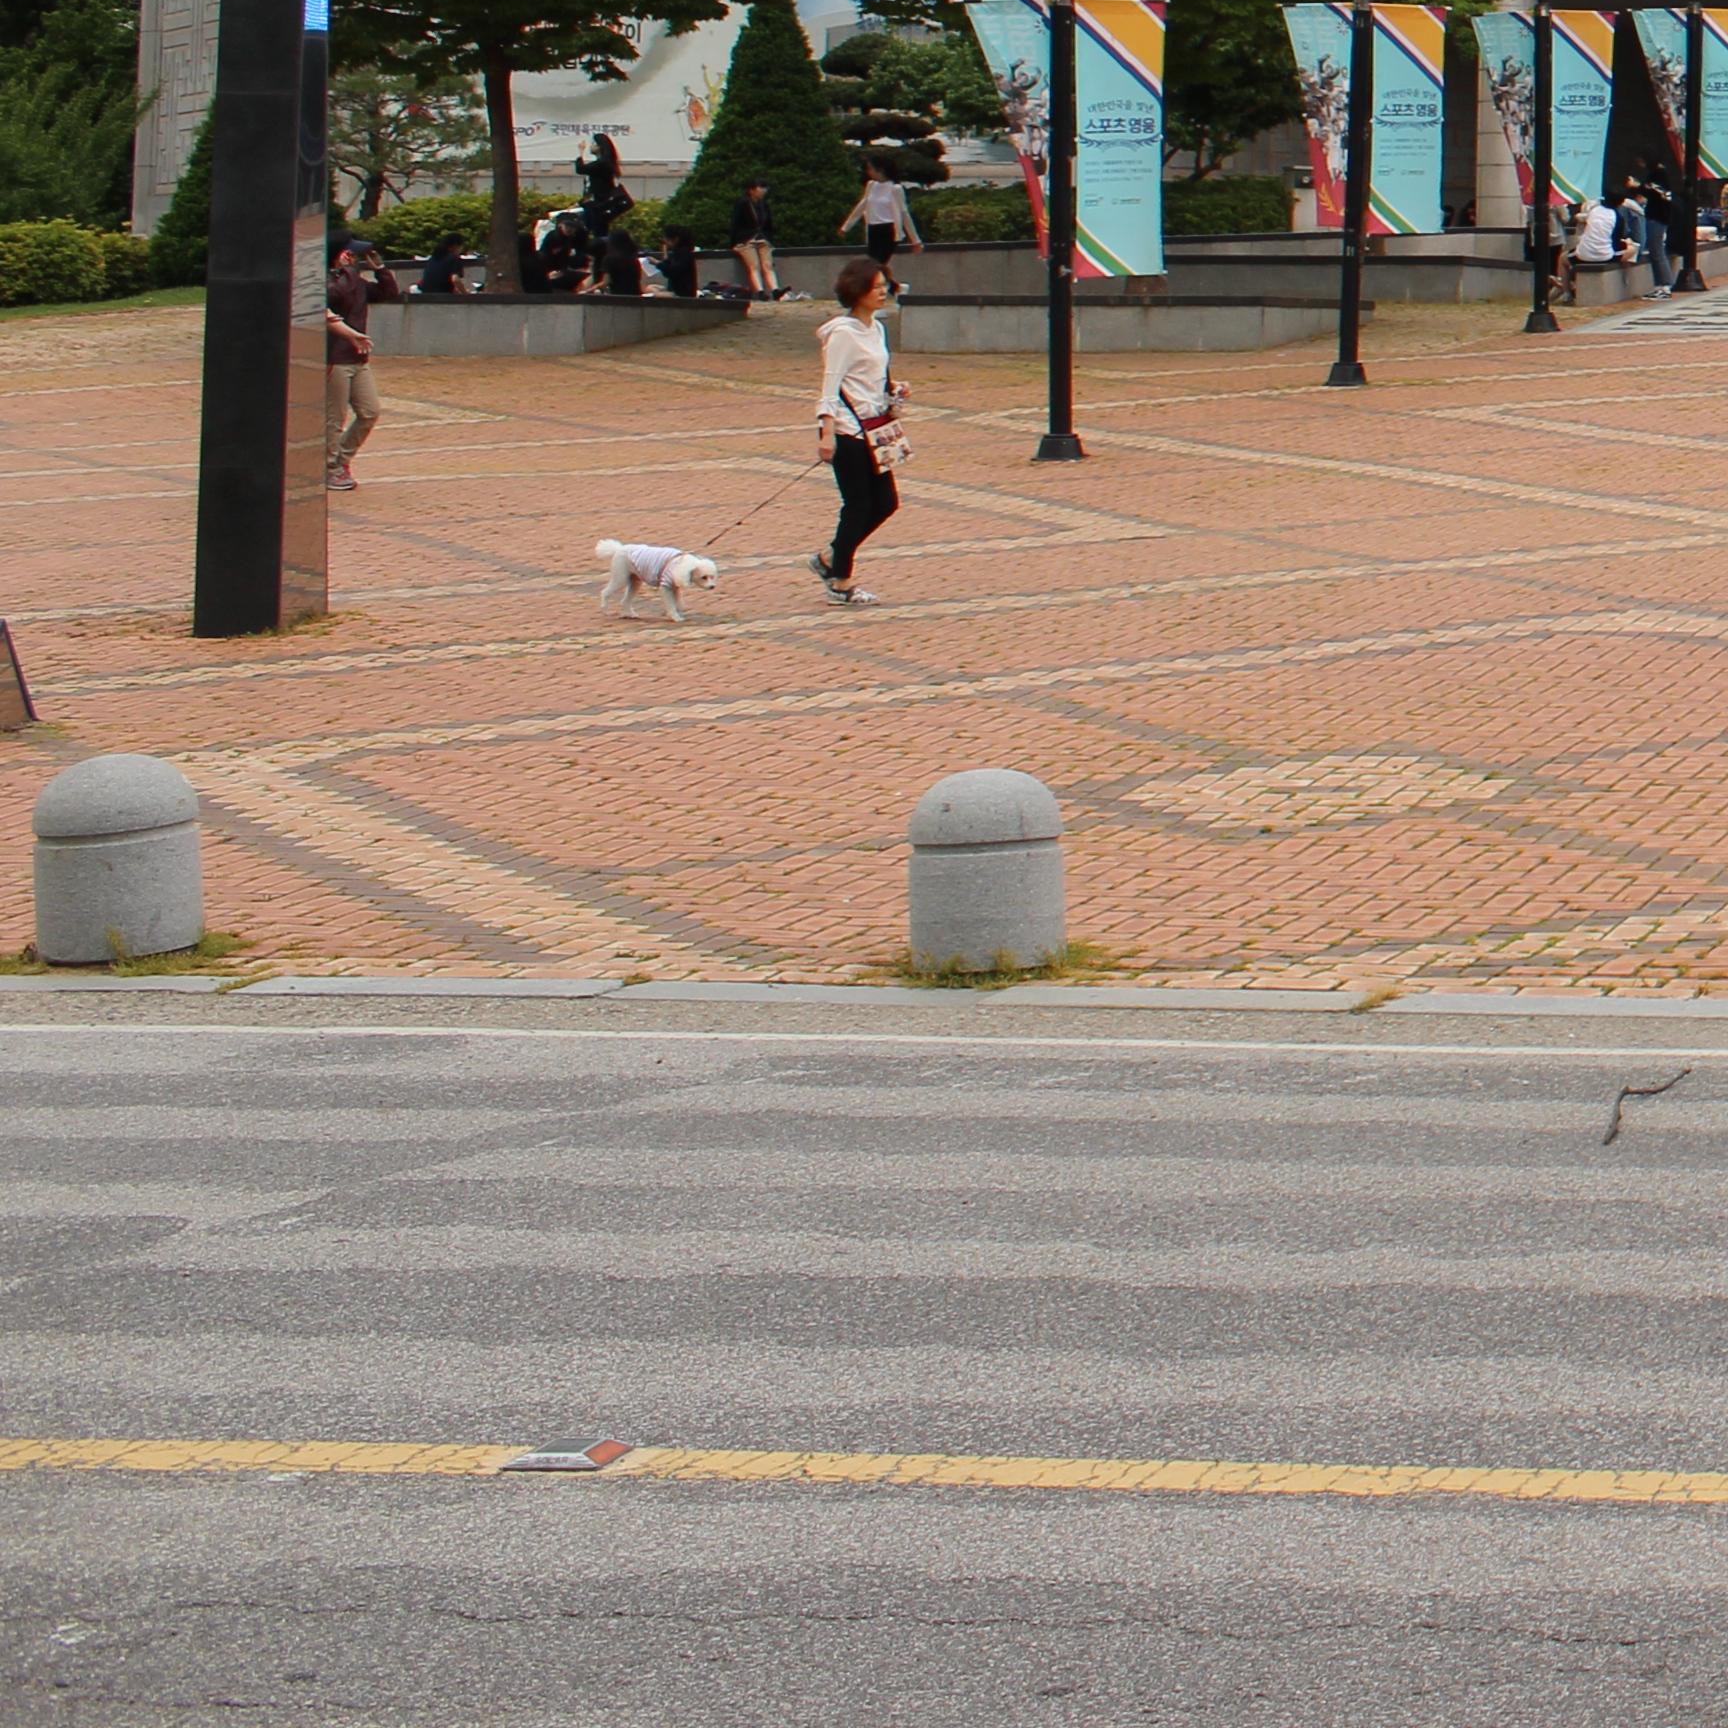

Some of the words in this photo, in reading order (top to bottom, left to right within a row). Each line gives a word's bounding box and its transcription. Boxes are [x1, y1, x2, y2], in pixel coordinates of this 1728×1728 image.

[1379, 104, 1415, 117] 스포츠
[1085, 118, 1127, 133] 스포츠
[1128, 117, 1156, 133] 영웅
